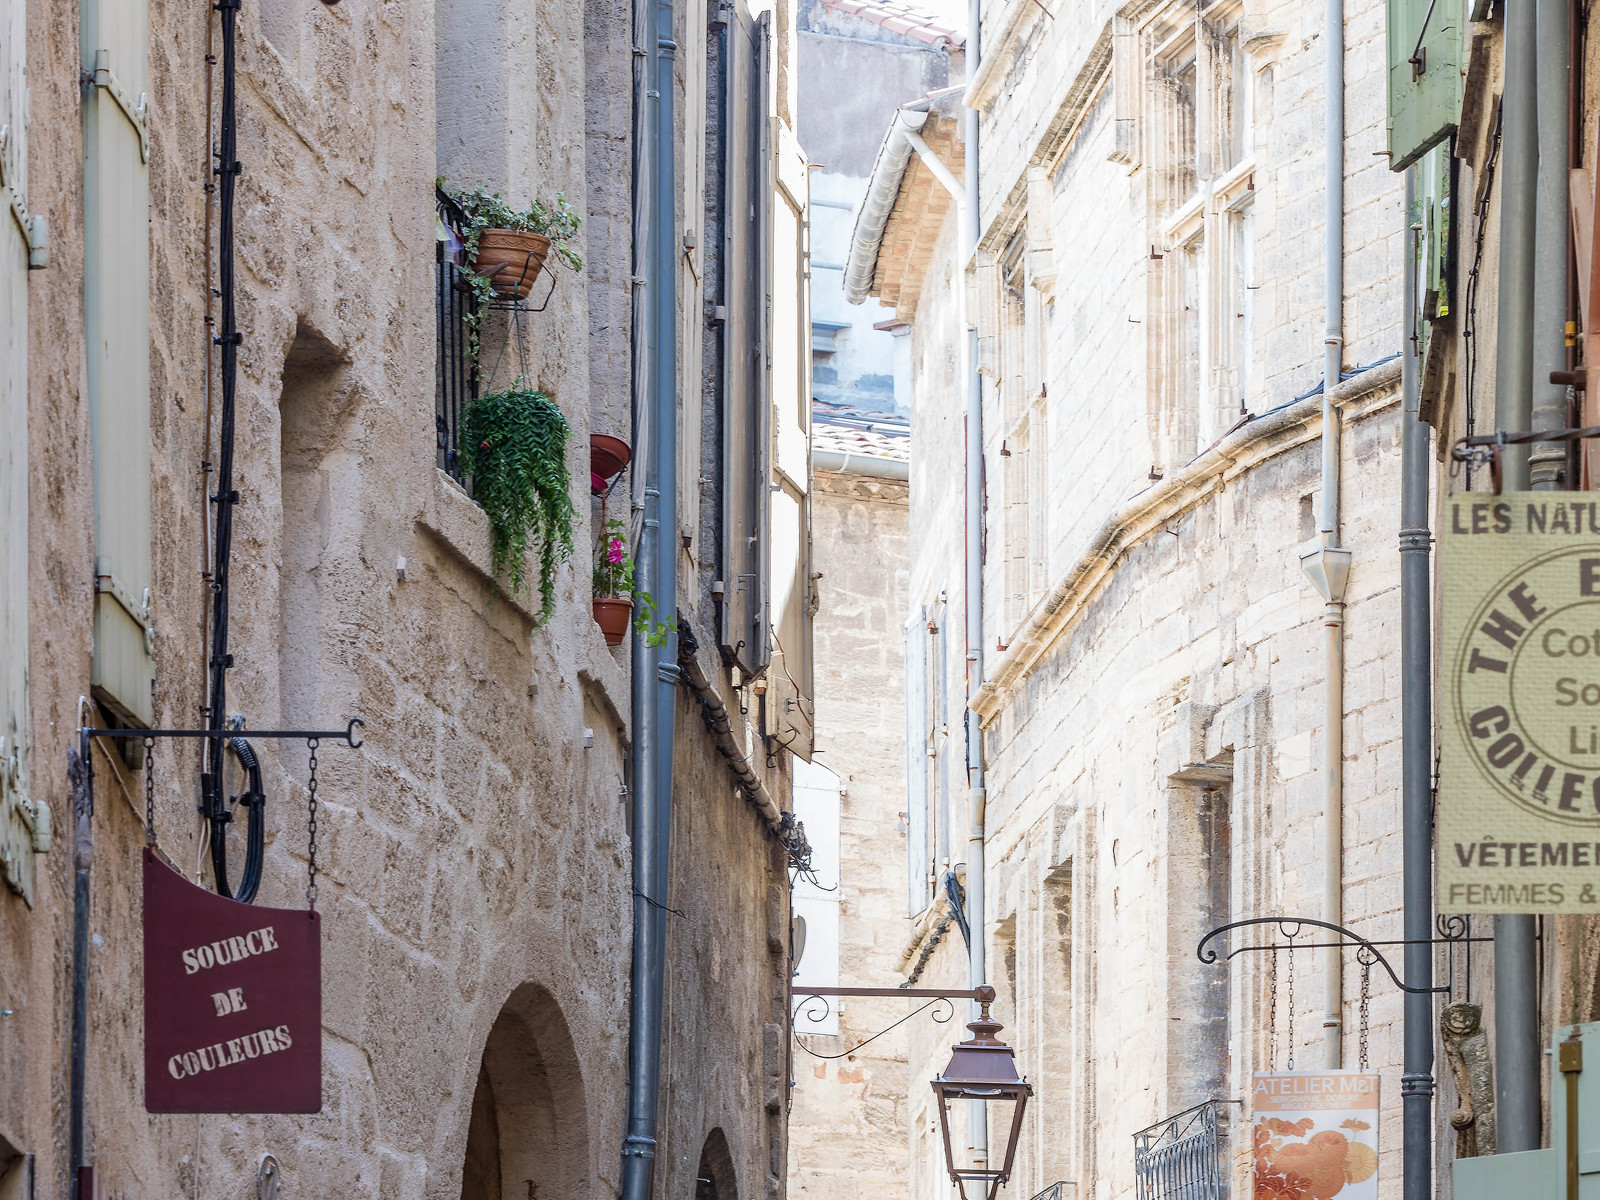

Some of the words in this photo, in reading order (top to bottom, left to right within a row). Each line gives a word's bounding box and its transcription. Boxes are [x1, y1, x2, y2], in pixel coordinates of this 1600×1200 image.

[1452, 503, 1511, 534] LES
[1467, 581, 1547, 674] THE
[1555, 677, 1600, 706] So
[1570, 725, 1597, 754] Li
[1454, 835, 1600, 867] VÊTEME
[1449, 883, 1564, 905] FEMMES
[1579, 883, 1597, 904] &
[182, 926, 278, 975] SOURCE
[211, 987, 247, 1017] DE
[168, 1025, 292, 1079] COULEURS
[1255, 1077, 1335, 1095] ATELIER
[1340, 1076, 1378, 1093] M&T
